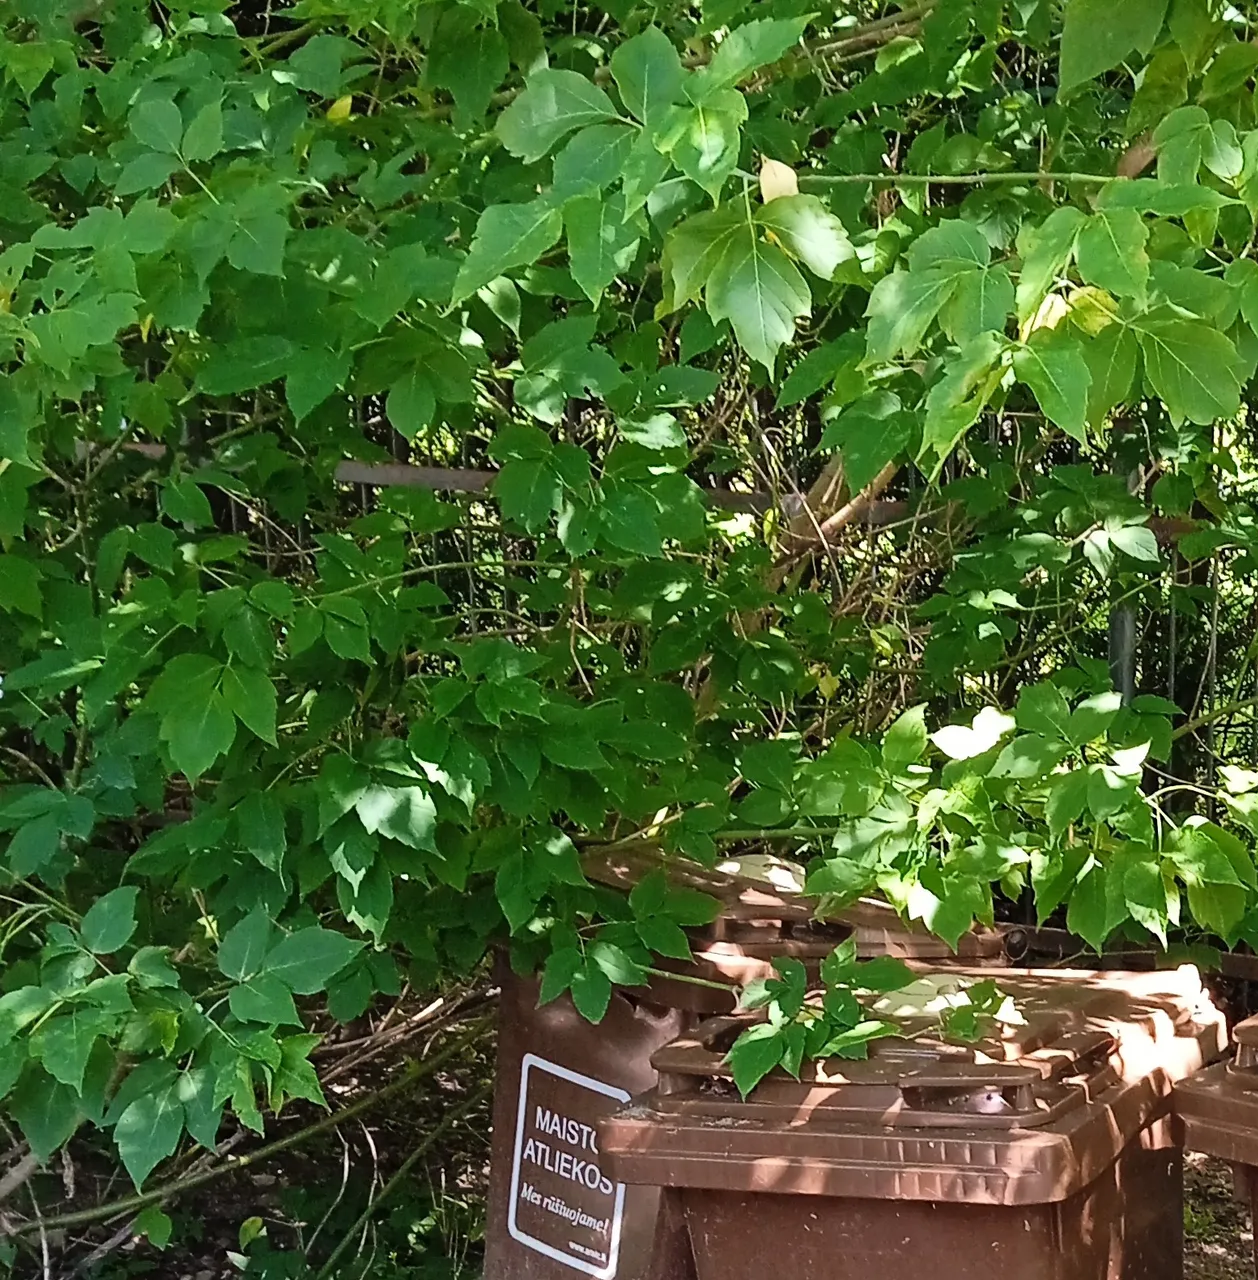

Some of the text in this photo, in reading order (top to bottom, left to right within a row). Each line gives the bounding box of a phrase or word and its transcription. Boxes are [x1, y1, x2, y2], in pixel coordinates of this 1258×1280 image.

[522, 1138, 614, 1195] ATLIEKOS
[520, 1182, 610, 1237] Mes rūšiuojame!
